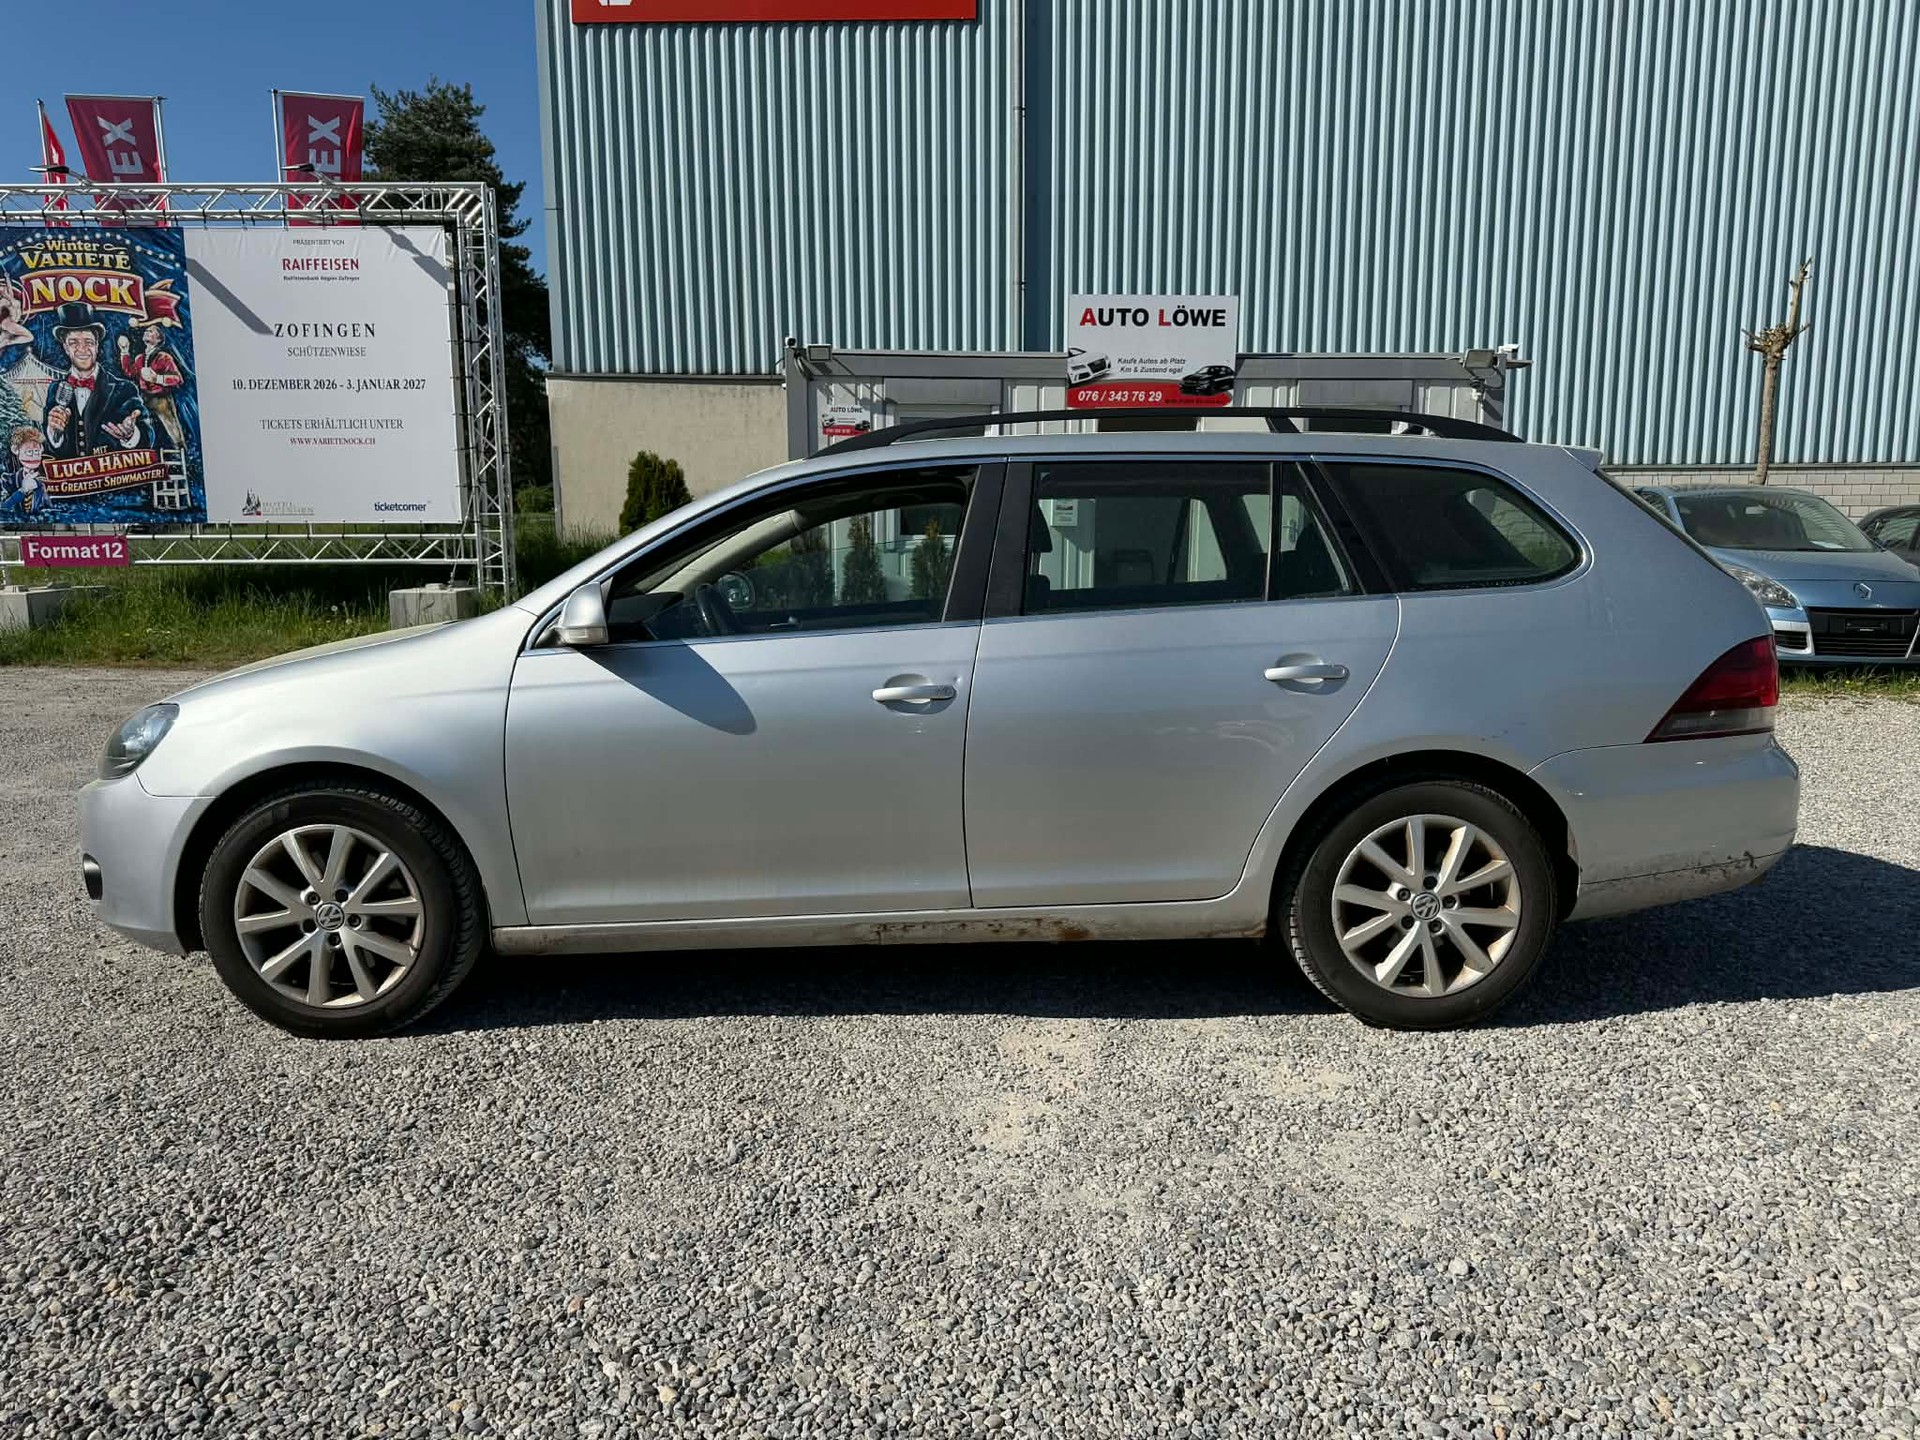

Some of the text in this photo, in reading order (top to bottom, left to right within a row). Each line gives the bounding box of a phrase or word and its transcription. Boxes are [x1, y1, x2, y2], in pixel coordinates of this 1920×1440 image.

[45, 240, 100, 251] Winter
[19, 251, 131, 270] VARIETÉ
[282, 258, 360, 271] RAIFFEISEN
[30, 276, 137, 306] NOCK
[1079, 305, 1226, 327] AUTO LÖWE
[274, 323, 376, 338] ZOFINGEN
[287, 345, 367, 357] SCHÜTZENWIESE
[1168, 367, 1183, 375] egal
[232, 379, 247, 391] 10.
[248, 379, 311, 391] DEZEMBER
[313, 379, 338, 391] 2026
[346, 379, 355, 391] 3.
[355, 379, 400, 393] JANUAR
[403, 379, 427, 391] 2027
[1078, 391, 1099, 402] 076
[1100, 391, 1106, 402] /
[1109, 391, 1129, 402] 343
[1131, 391, 1146, 402] 76
[1148, 391, 1163, 402] 29
[259, 417, 404, 430] TICKETS ERHÄLTLICH UNTER
[290, 437, 376, 446] WWW.VARIETENOCK.CH
[93, 445, 108, 455] MIT
[52, 452, 151, 479] LUCA HÄNNI
[61, 479, 103, 493] GREATEST
[104, 469, 165, 486] SHOWMASTER!
[374, 501, 427, 512] ticketcorner
[28, 542, 124, 559] Format 12
